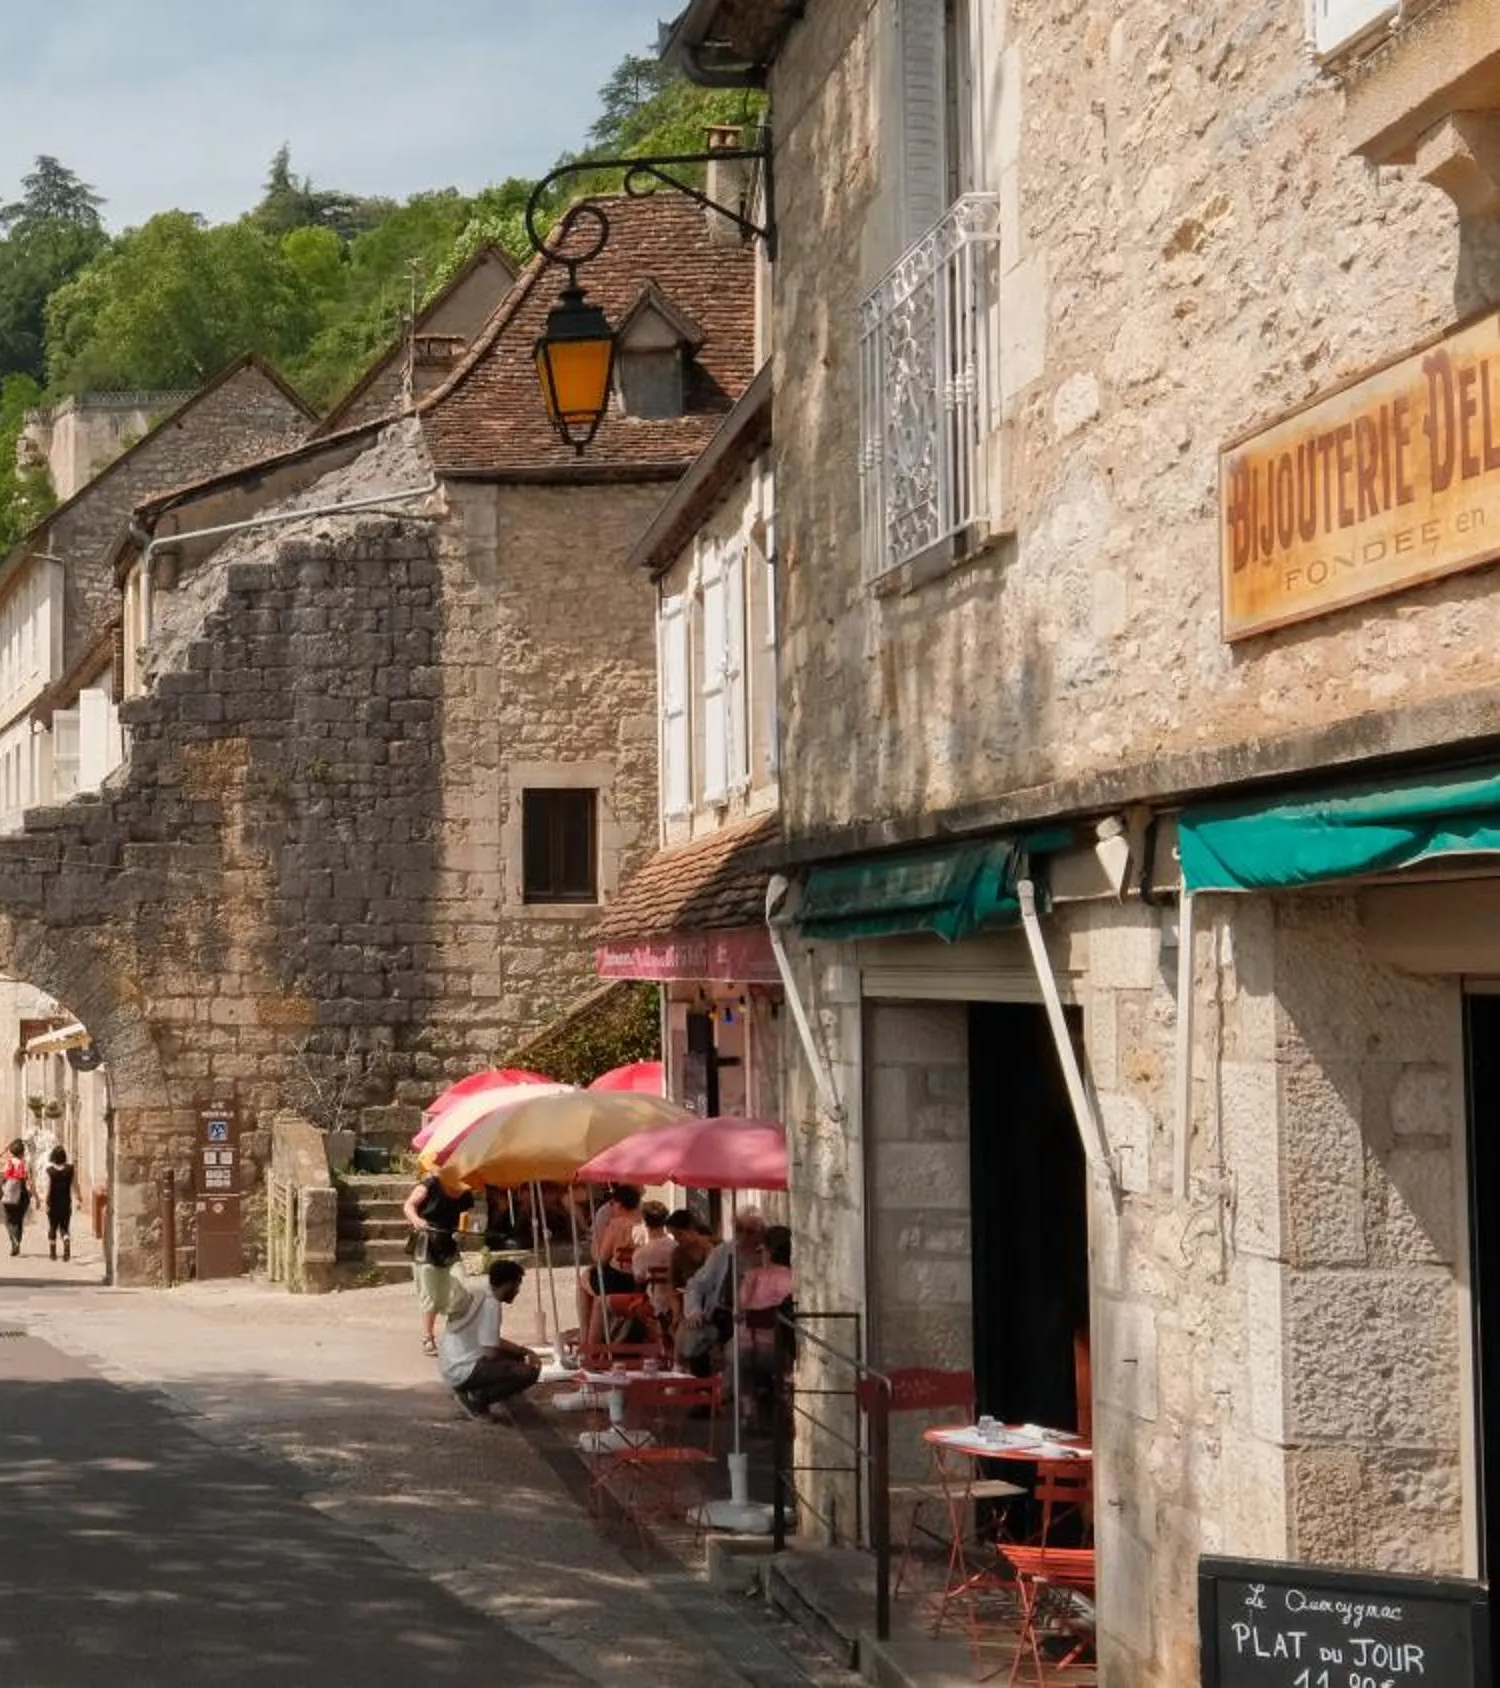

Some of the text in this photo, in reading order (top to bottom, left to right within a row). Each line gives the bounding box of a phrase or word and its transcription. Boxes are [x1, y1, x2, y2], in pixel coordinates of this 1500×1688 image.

[1227, 395, 1415, 575] BIJOUTERIE
[1455, 507, 1486, 534] en
[1245, 1583, 1268, 1609] Le
[1231, 1622, 1308, 1660] PLAT
[1348, 1638, 1425, 1674] JOUR
